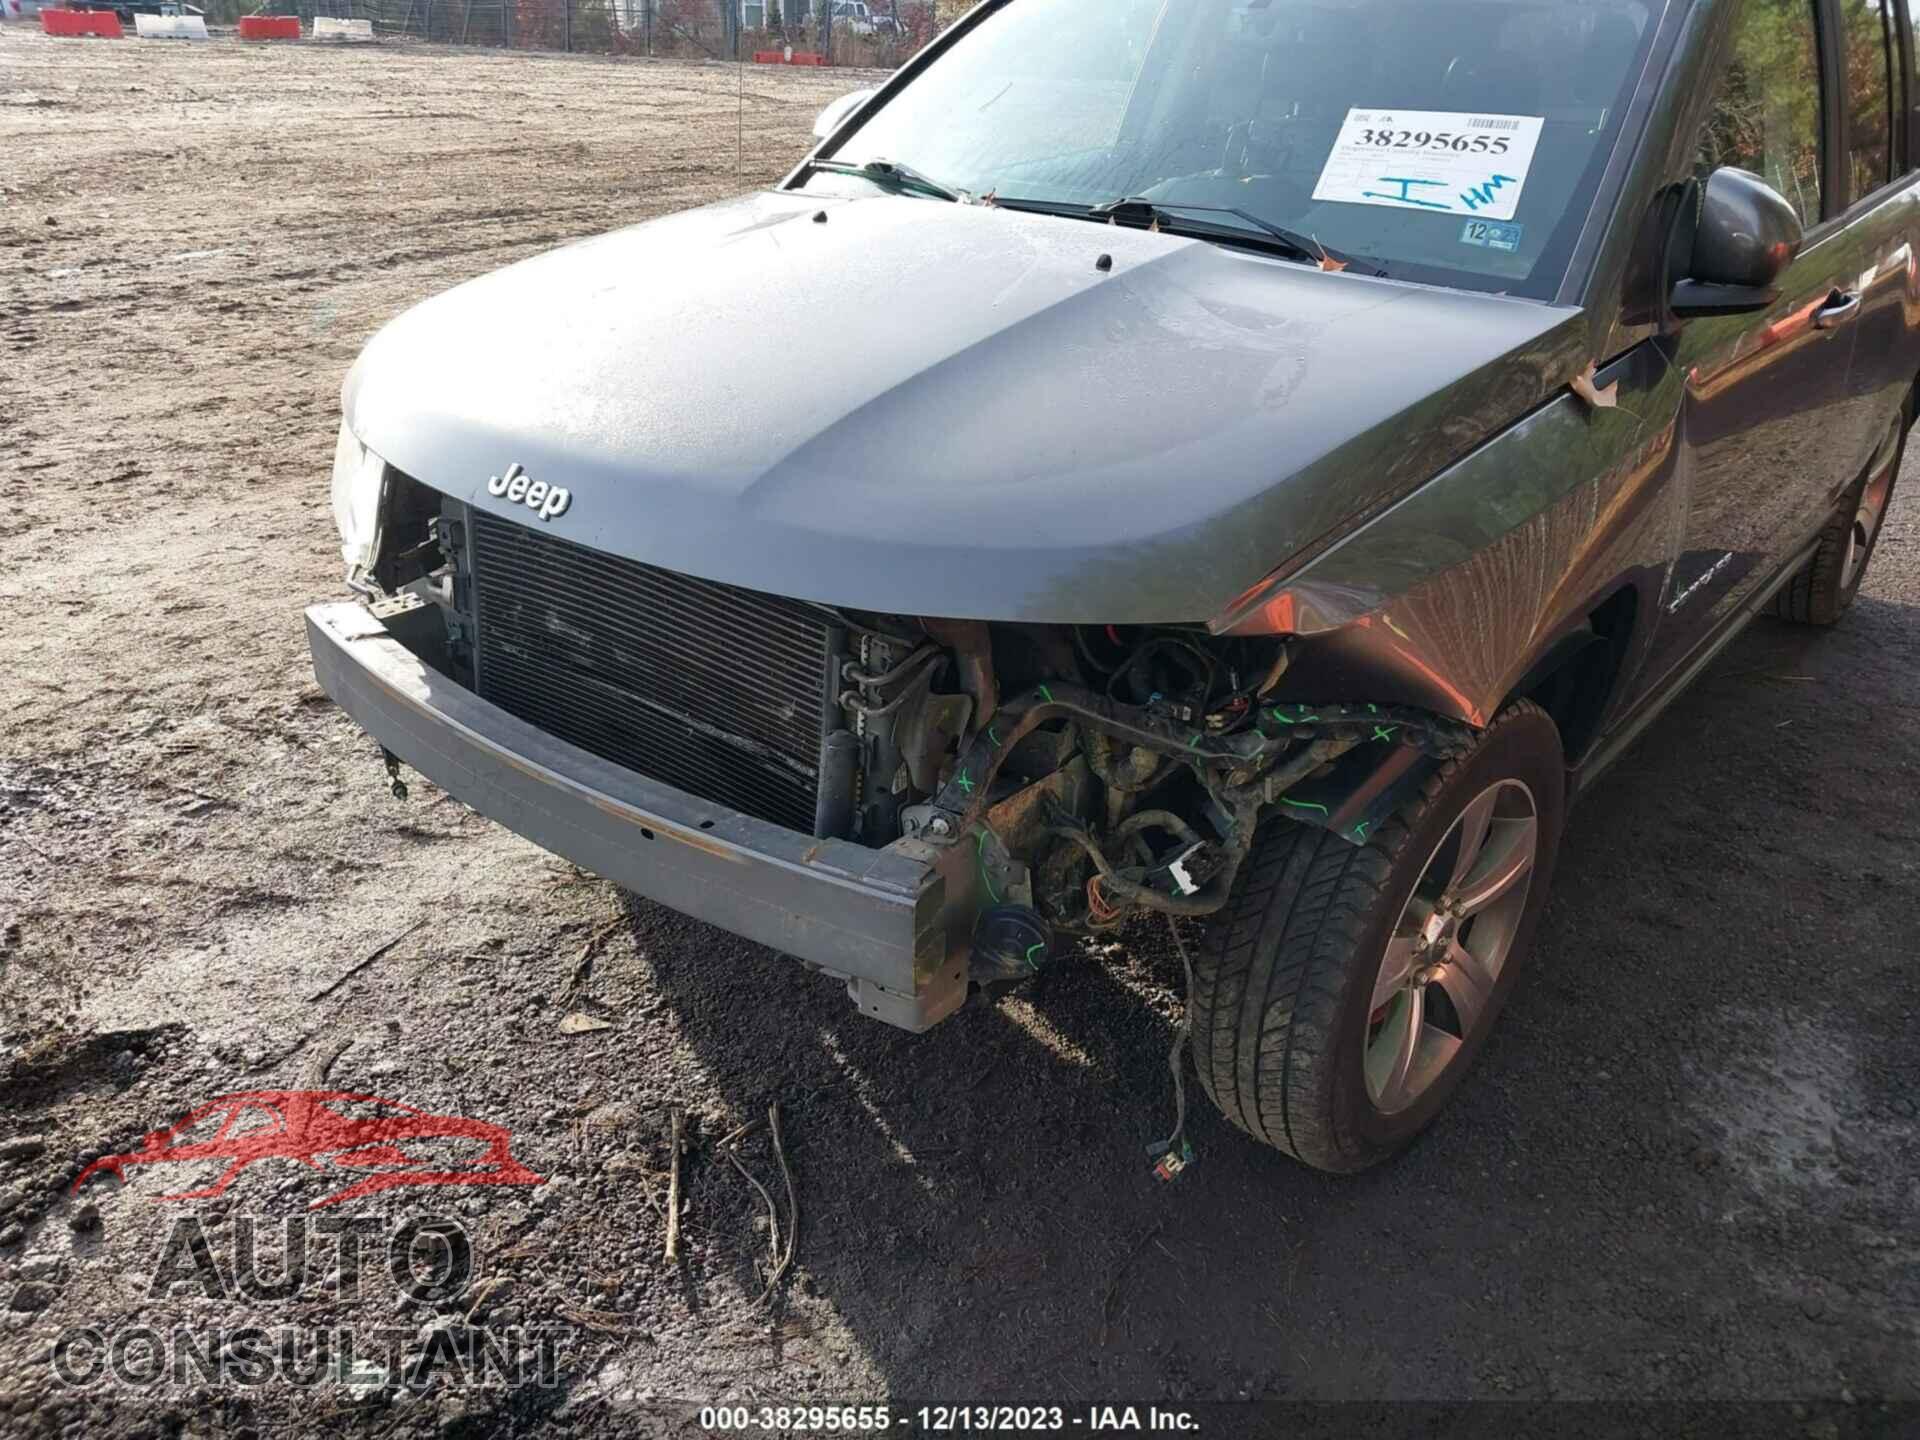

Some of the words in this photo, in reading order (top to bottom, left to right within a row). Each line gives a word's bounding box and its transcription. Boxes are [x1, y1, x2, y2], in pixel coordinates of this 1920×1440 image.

[1355, 128, 1511, 155] 38295655
[1468, 222, 1488, 240] 12
[487, 462, 573, 522] Jeep
